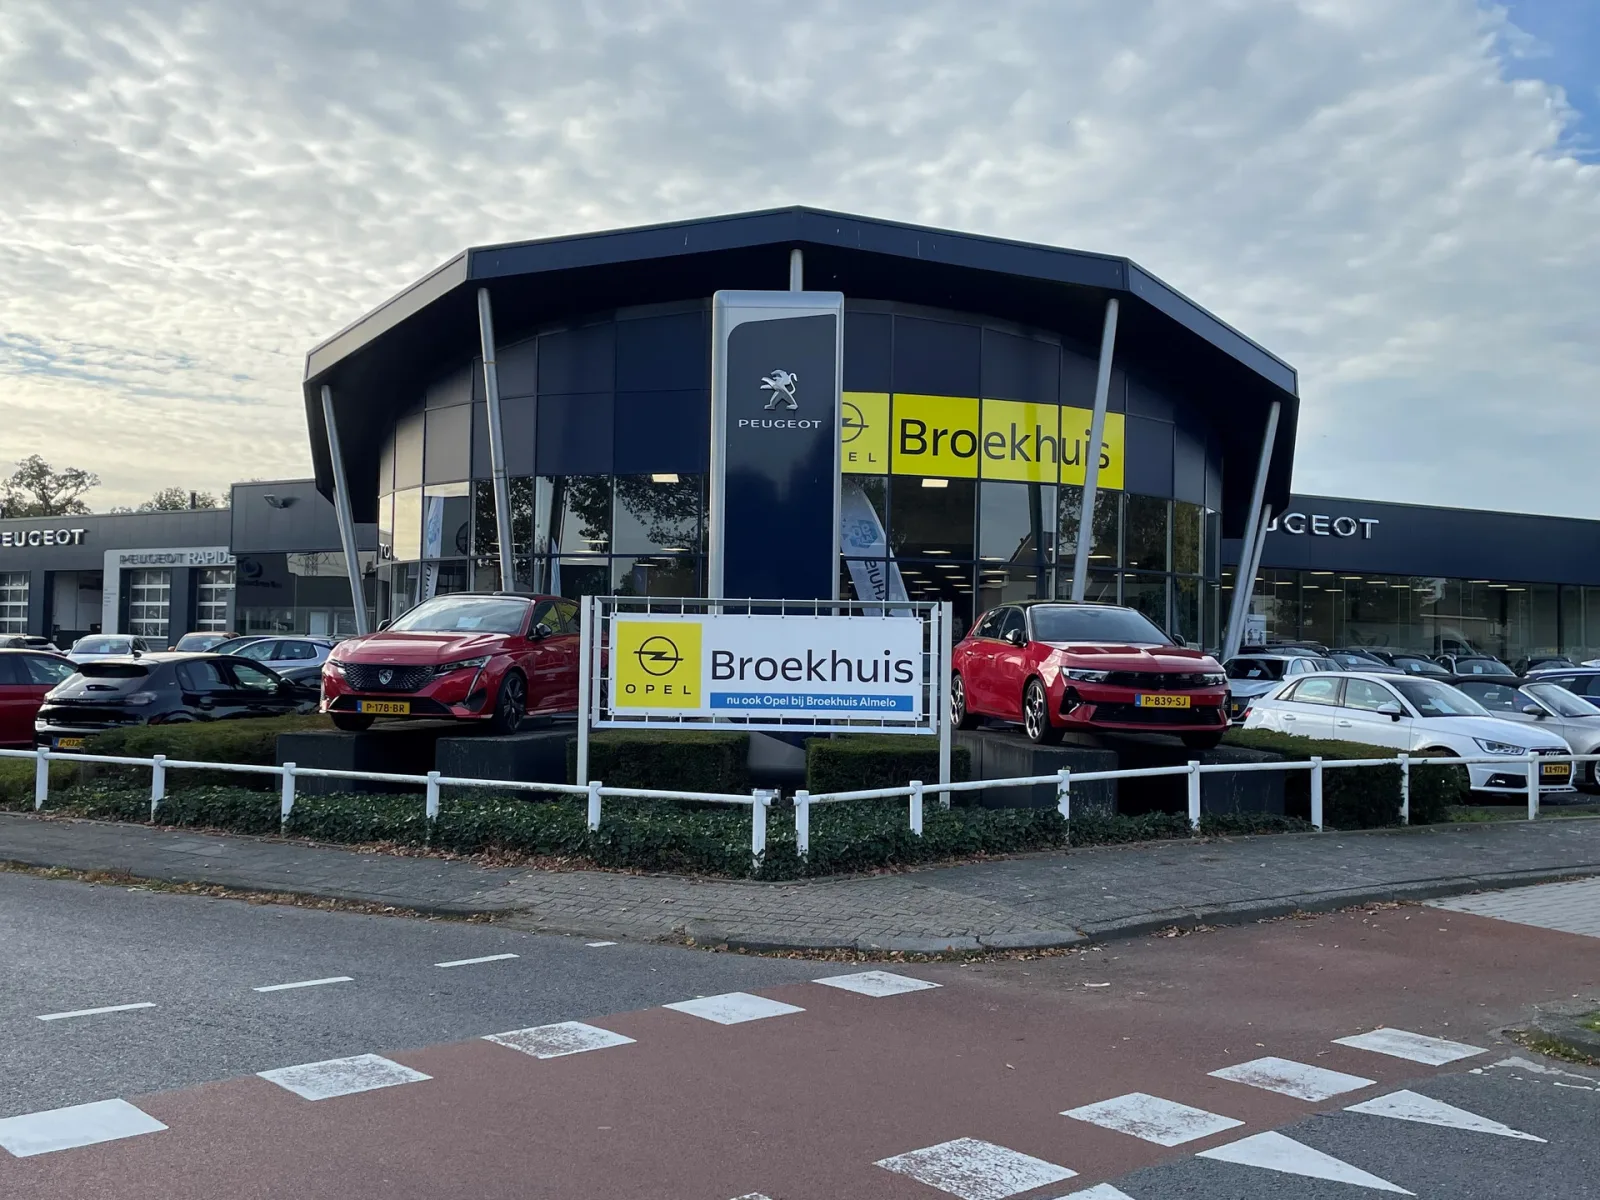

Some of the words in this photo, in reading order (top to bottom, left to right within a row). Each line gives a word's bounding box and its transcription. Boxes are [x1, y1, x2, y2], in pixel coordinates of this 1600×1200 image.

[738, 419, 822, 429] PEUGEOT
[900, 418, 1110, 469] Broekhuis
[848, 451, 877, 463] EL
[1266, 512, 1379, 539] GEOT
[1, 528, 84, 547] EUGEOT
[119, 553, 187, 565] PEUGEOT
[711, 648, 914, 683] Broekhuis
[625, 683, 692, 695] OPEL
[726, 696, 740, 705] nu
[742, 695, 761, 705] ook
[763, 695, 789, 707] Opel
[791, 696, 804, 708] bij
[806, 696, 858, 707] Broekhuis
[859, 697, 897, 708] Almelo
[1144, 695, 1187, 706] P-839-SJ
[366, 703, 405, 713] P-178-BR
